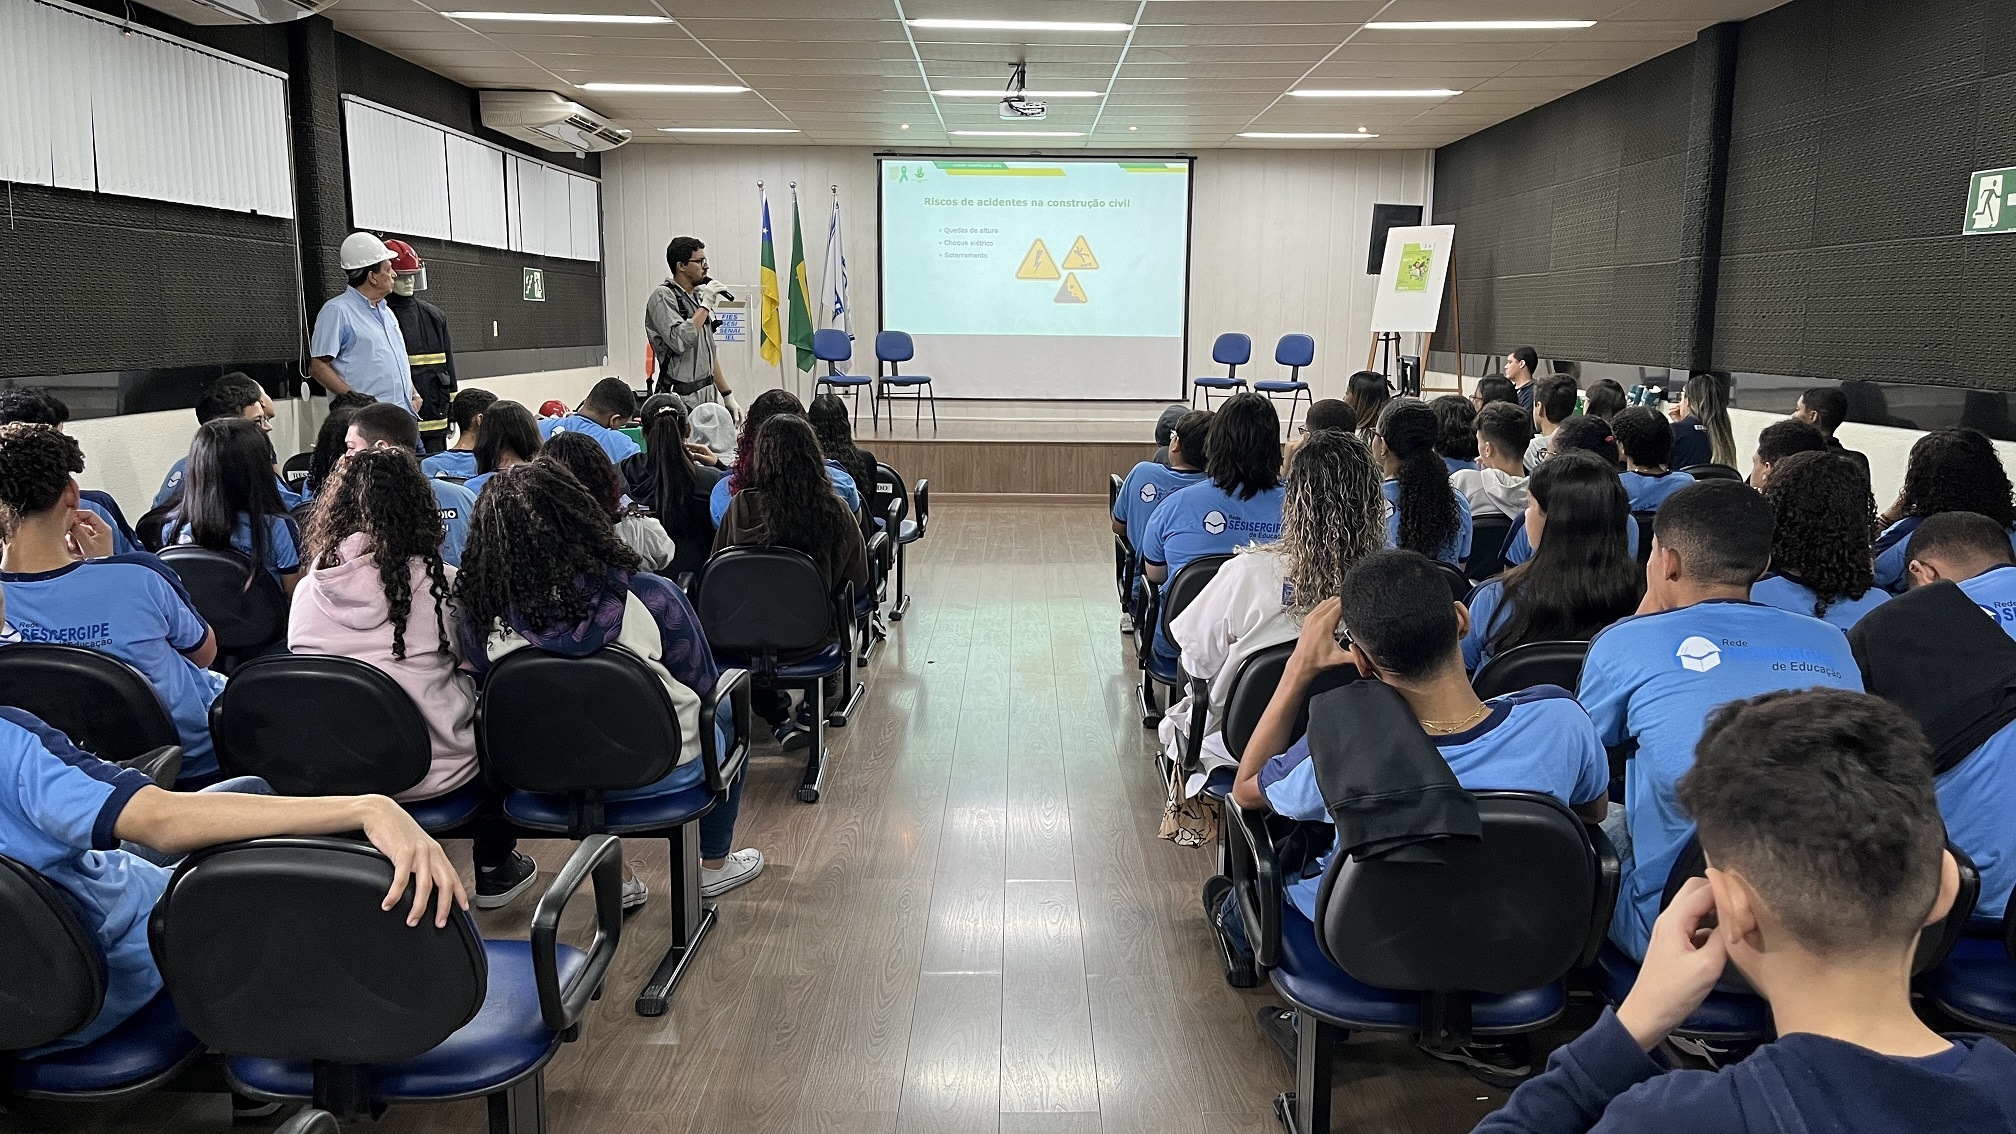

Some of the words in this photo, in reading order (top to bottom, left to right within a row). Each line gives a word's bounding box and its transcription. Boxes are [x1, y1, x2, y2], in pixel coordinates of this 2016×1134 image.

[924, 197, 959, 206] Riscos
[961, 197, 975, 206] de
[977, 197, 1029, 207] acidentes
[1031, 199, 1044, 207] na
[1047, 198, 1106, 209] construção
[1108, 198, 1131, 208] civil
[943, 227, 969, 235] Quedas
[943, 239, 969, 248] Choque
[970, 239, 994, 247] elétrico
[1228, 521, 1281, 533] SESISERGIP
[1722, 638, 1748, 647] Rede
[1772, 661, 1787, 671] de
[1790, 661, 1842, 680] Educação
